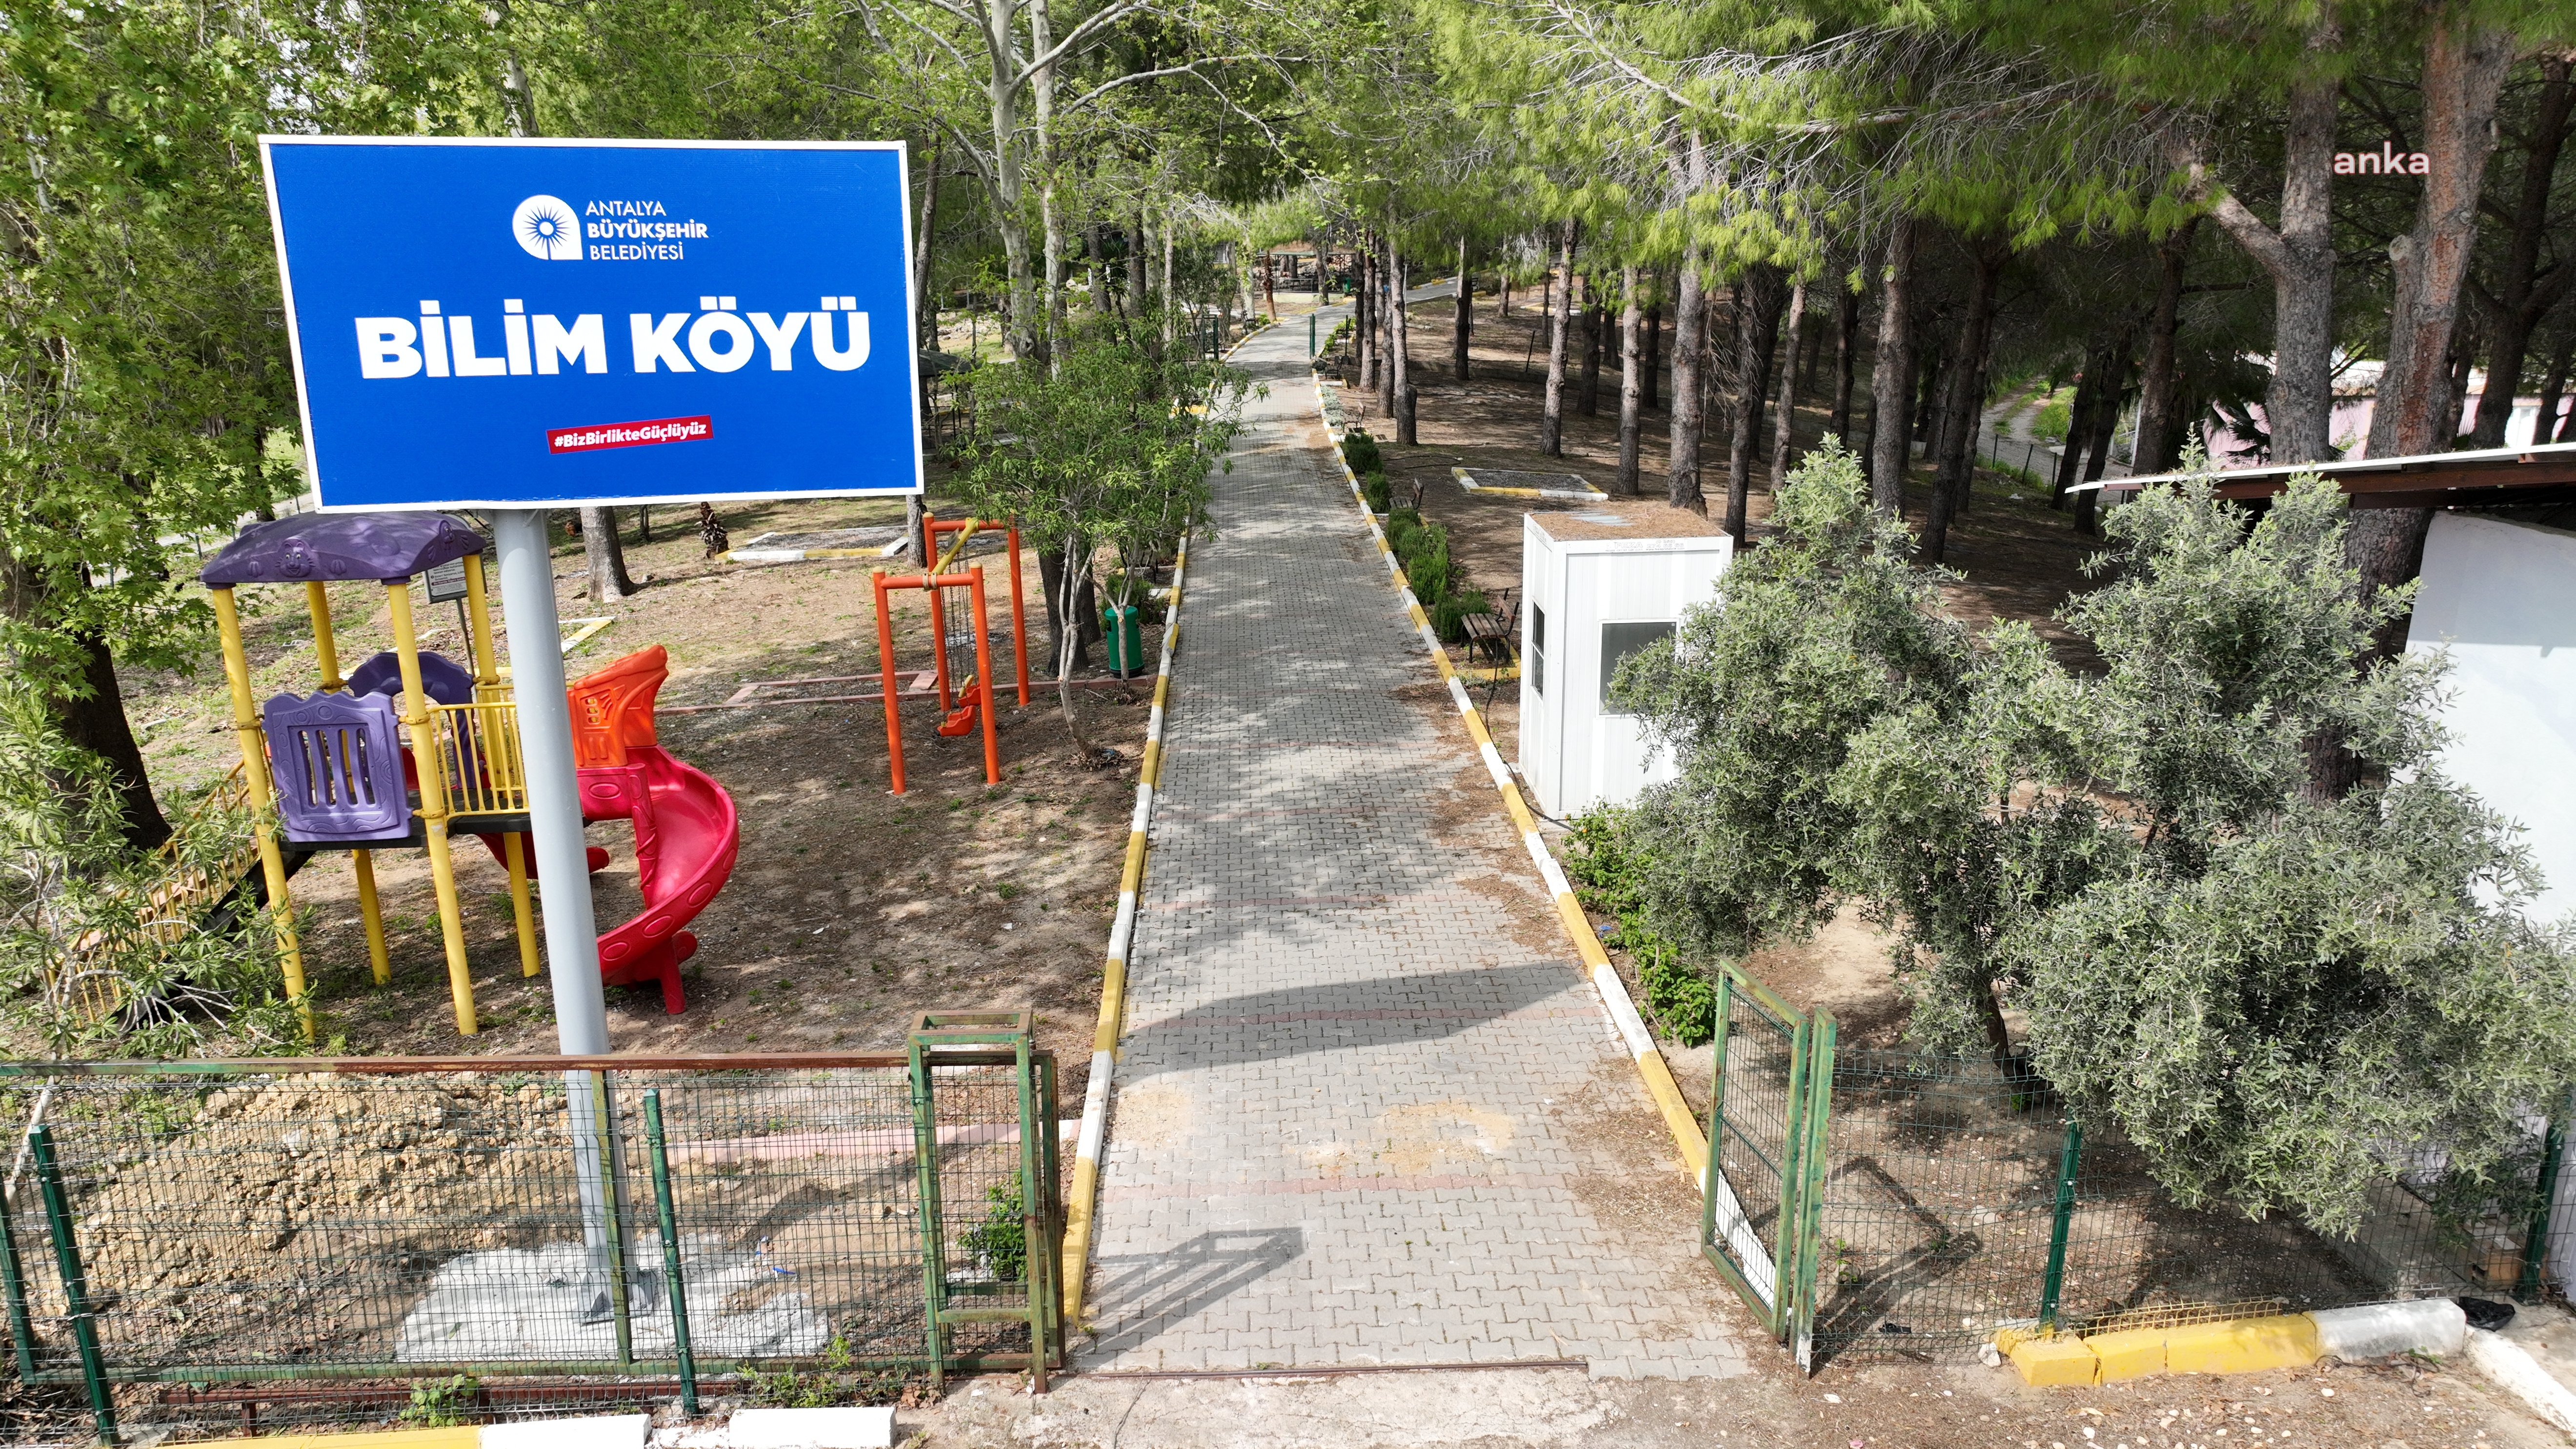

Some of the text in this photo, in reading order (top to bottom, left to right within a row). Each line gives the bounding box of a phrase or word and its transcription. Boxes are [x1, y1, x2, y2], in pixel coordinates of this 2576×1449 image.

[585, 201, 667, 216] ANTALYA
[588, 218, 709, 242] BÜYÜKŞEHİR
[590, 241, 684, 260] BELEDİYESİ
[355, 296, 870, 379] BİLİM KÖYÜ
[554, 422, 706, 447] #BizBirlikteGüçlüyüz
